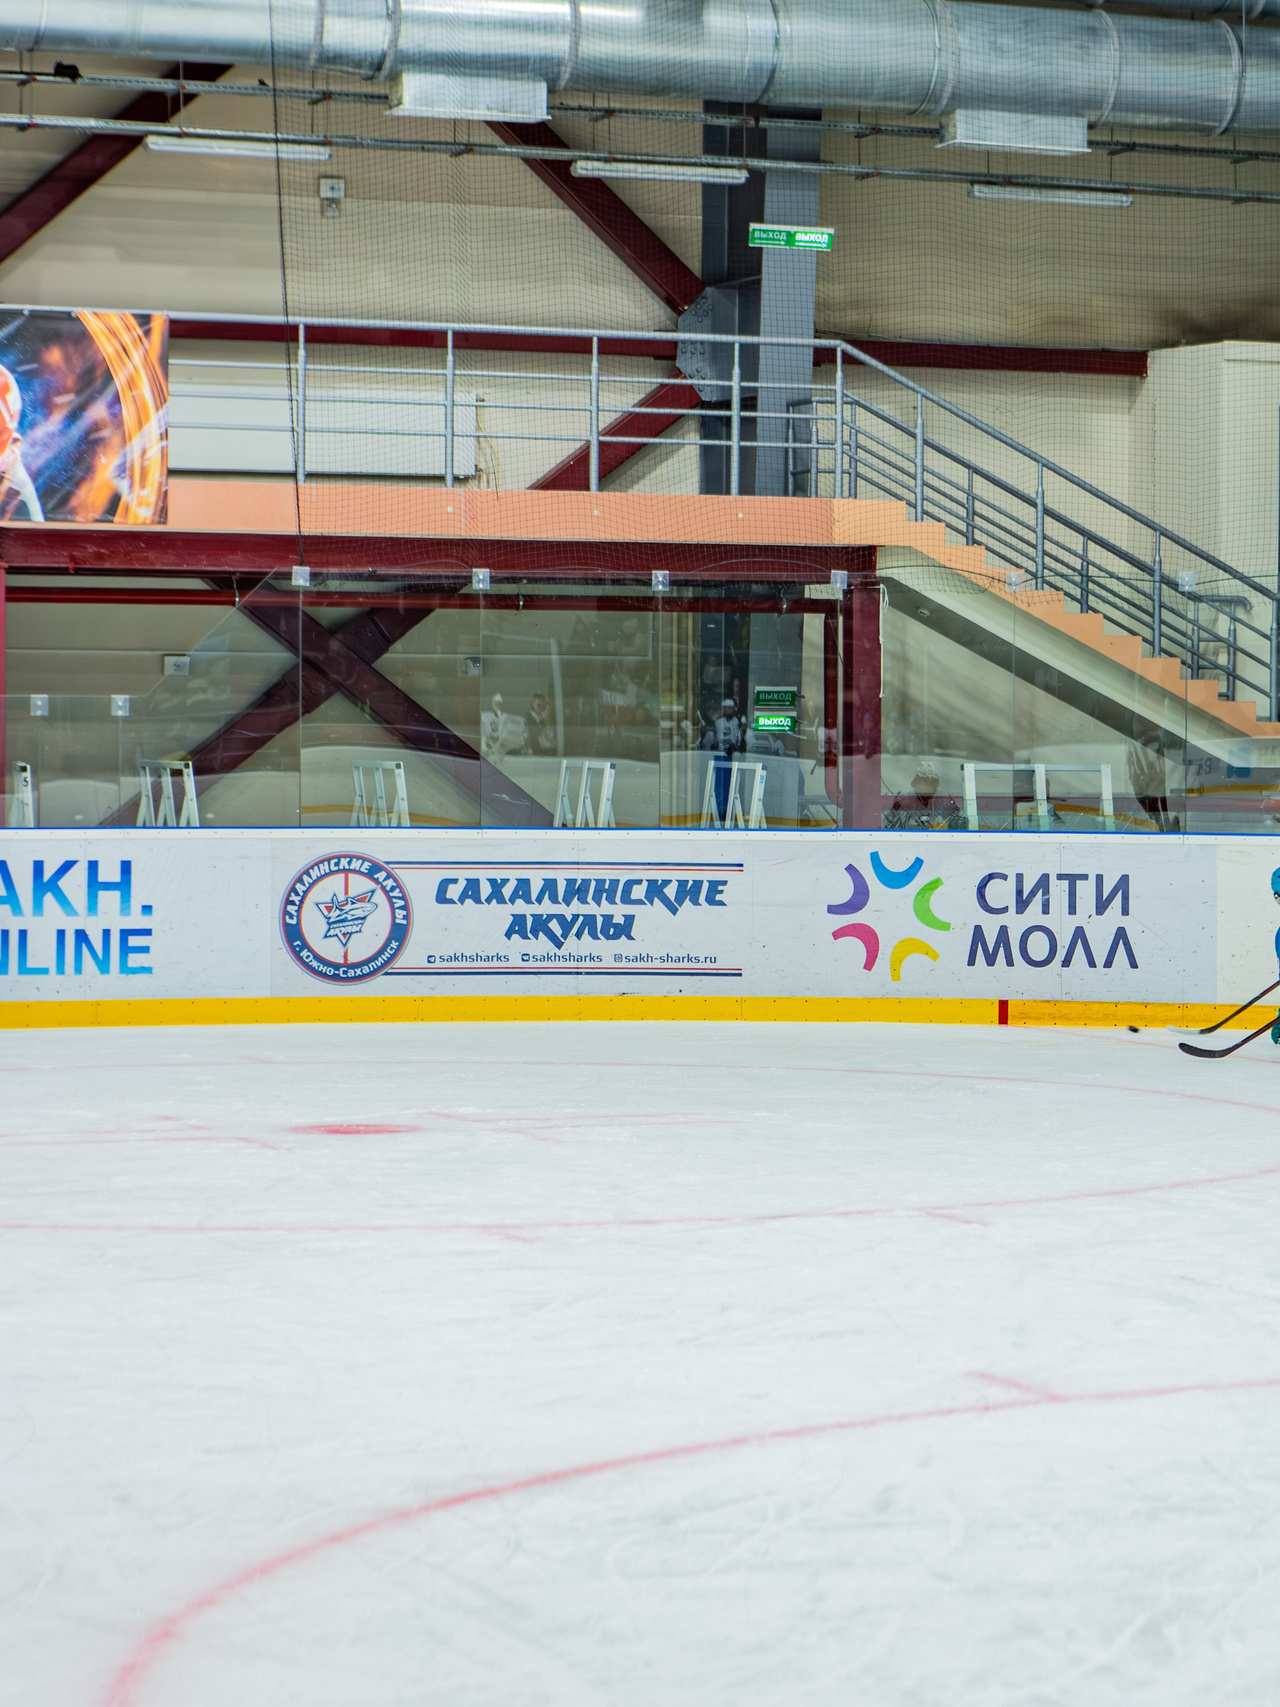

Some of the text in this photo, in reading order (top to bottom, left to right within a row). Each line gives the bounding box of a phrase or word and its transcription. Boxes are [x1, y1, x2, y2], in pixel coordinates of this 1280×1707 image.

[754, 230, 787, 240] ВЫХОД
[795, 232, 829, 243] ВЫХОД
[759, 692, 792, 701] ВЫХОД
[758, 717, 791, 726] ВЫХОД
[285, 857, 408, 925] САХАЛИНСКИЕ АКУЛЫ
[434, 877, 729, 917] САХАЛИНСКИЕ
[975, 871, 1130, 917] СИТИ
[503, 913, 637, 951] АКУЛЫ
[966, 924, 1139, 969] МОЛЛ
[300, 939, 400, 978] Южно-Сахалинск
[438, 952, 717, 964] sakhsharks sakhsharks sakh-sharks.ru
